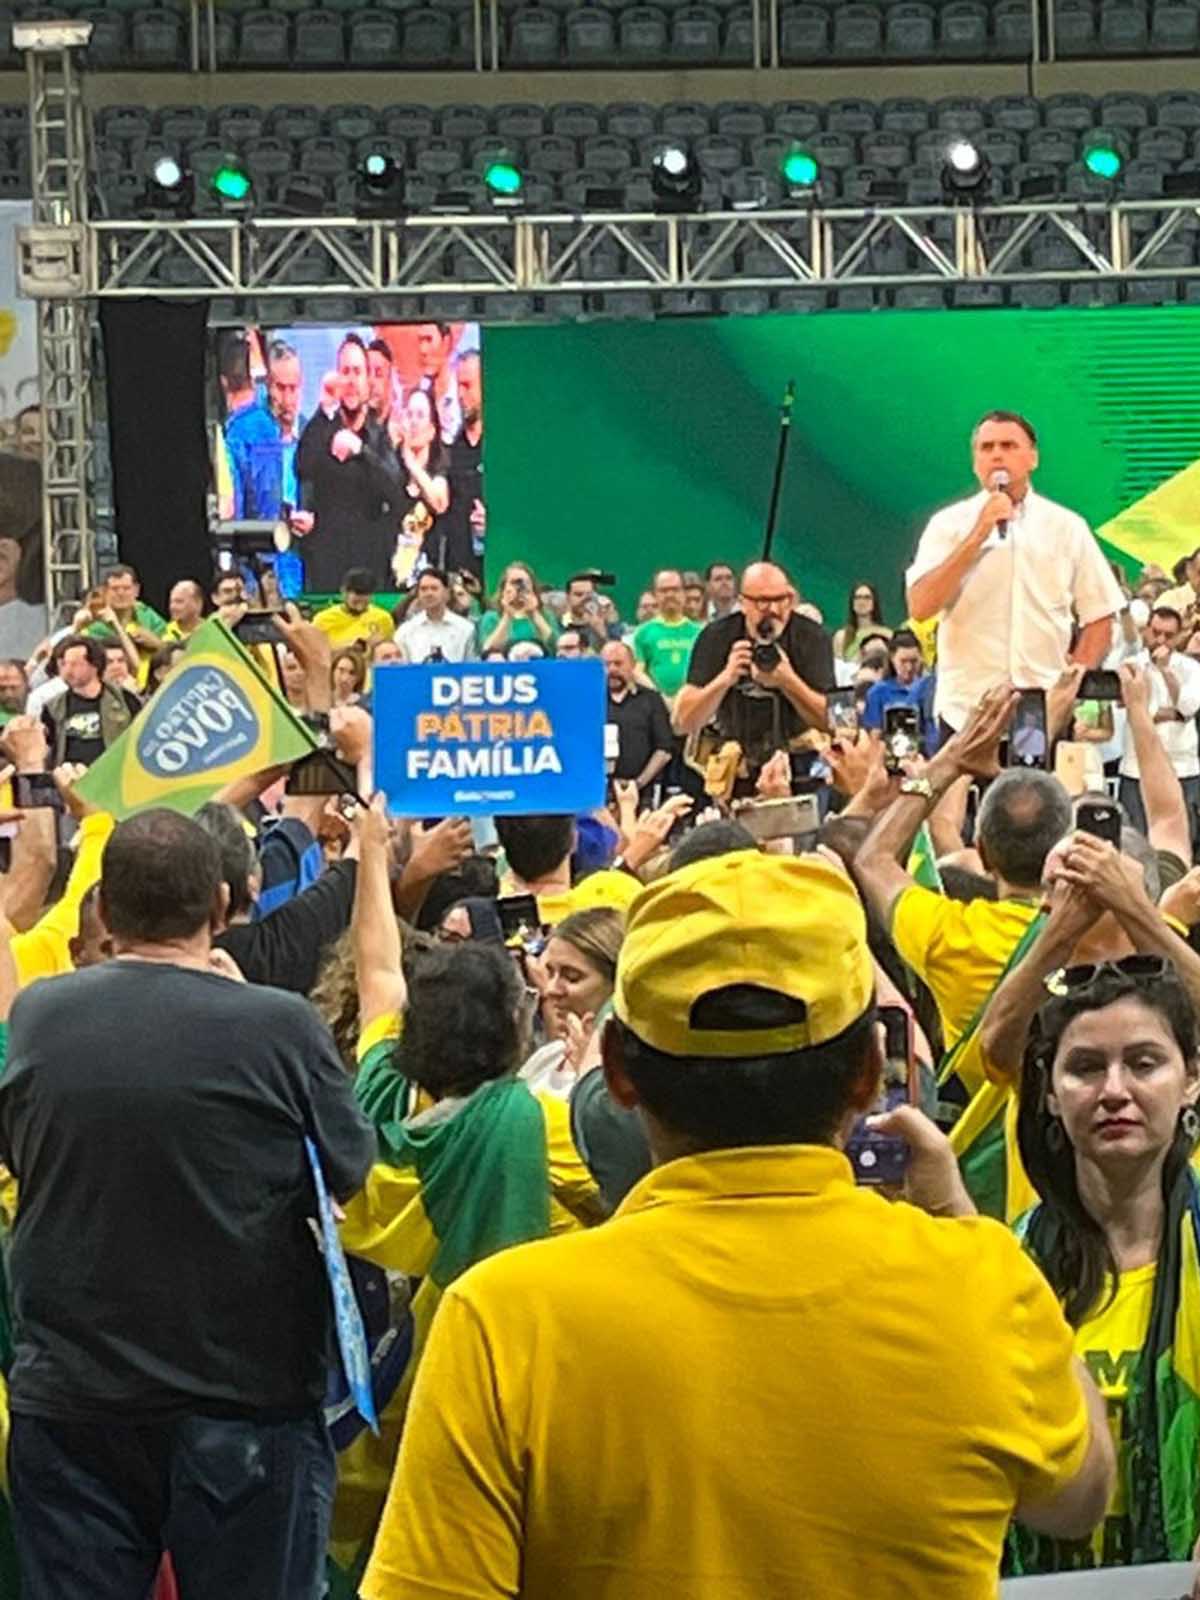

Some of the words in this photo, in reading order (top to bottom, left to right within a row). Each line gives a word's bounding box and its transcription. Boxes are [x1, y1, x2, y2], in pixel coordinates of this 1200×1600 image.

[431, 674, 540, 706] DEUS
[416, 706, 554, 742] PÁTRIA
[406, 741, 563, 780] FAMÍLIA
